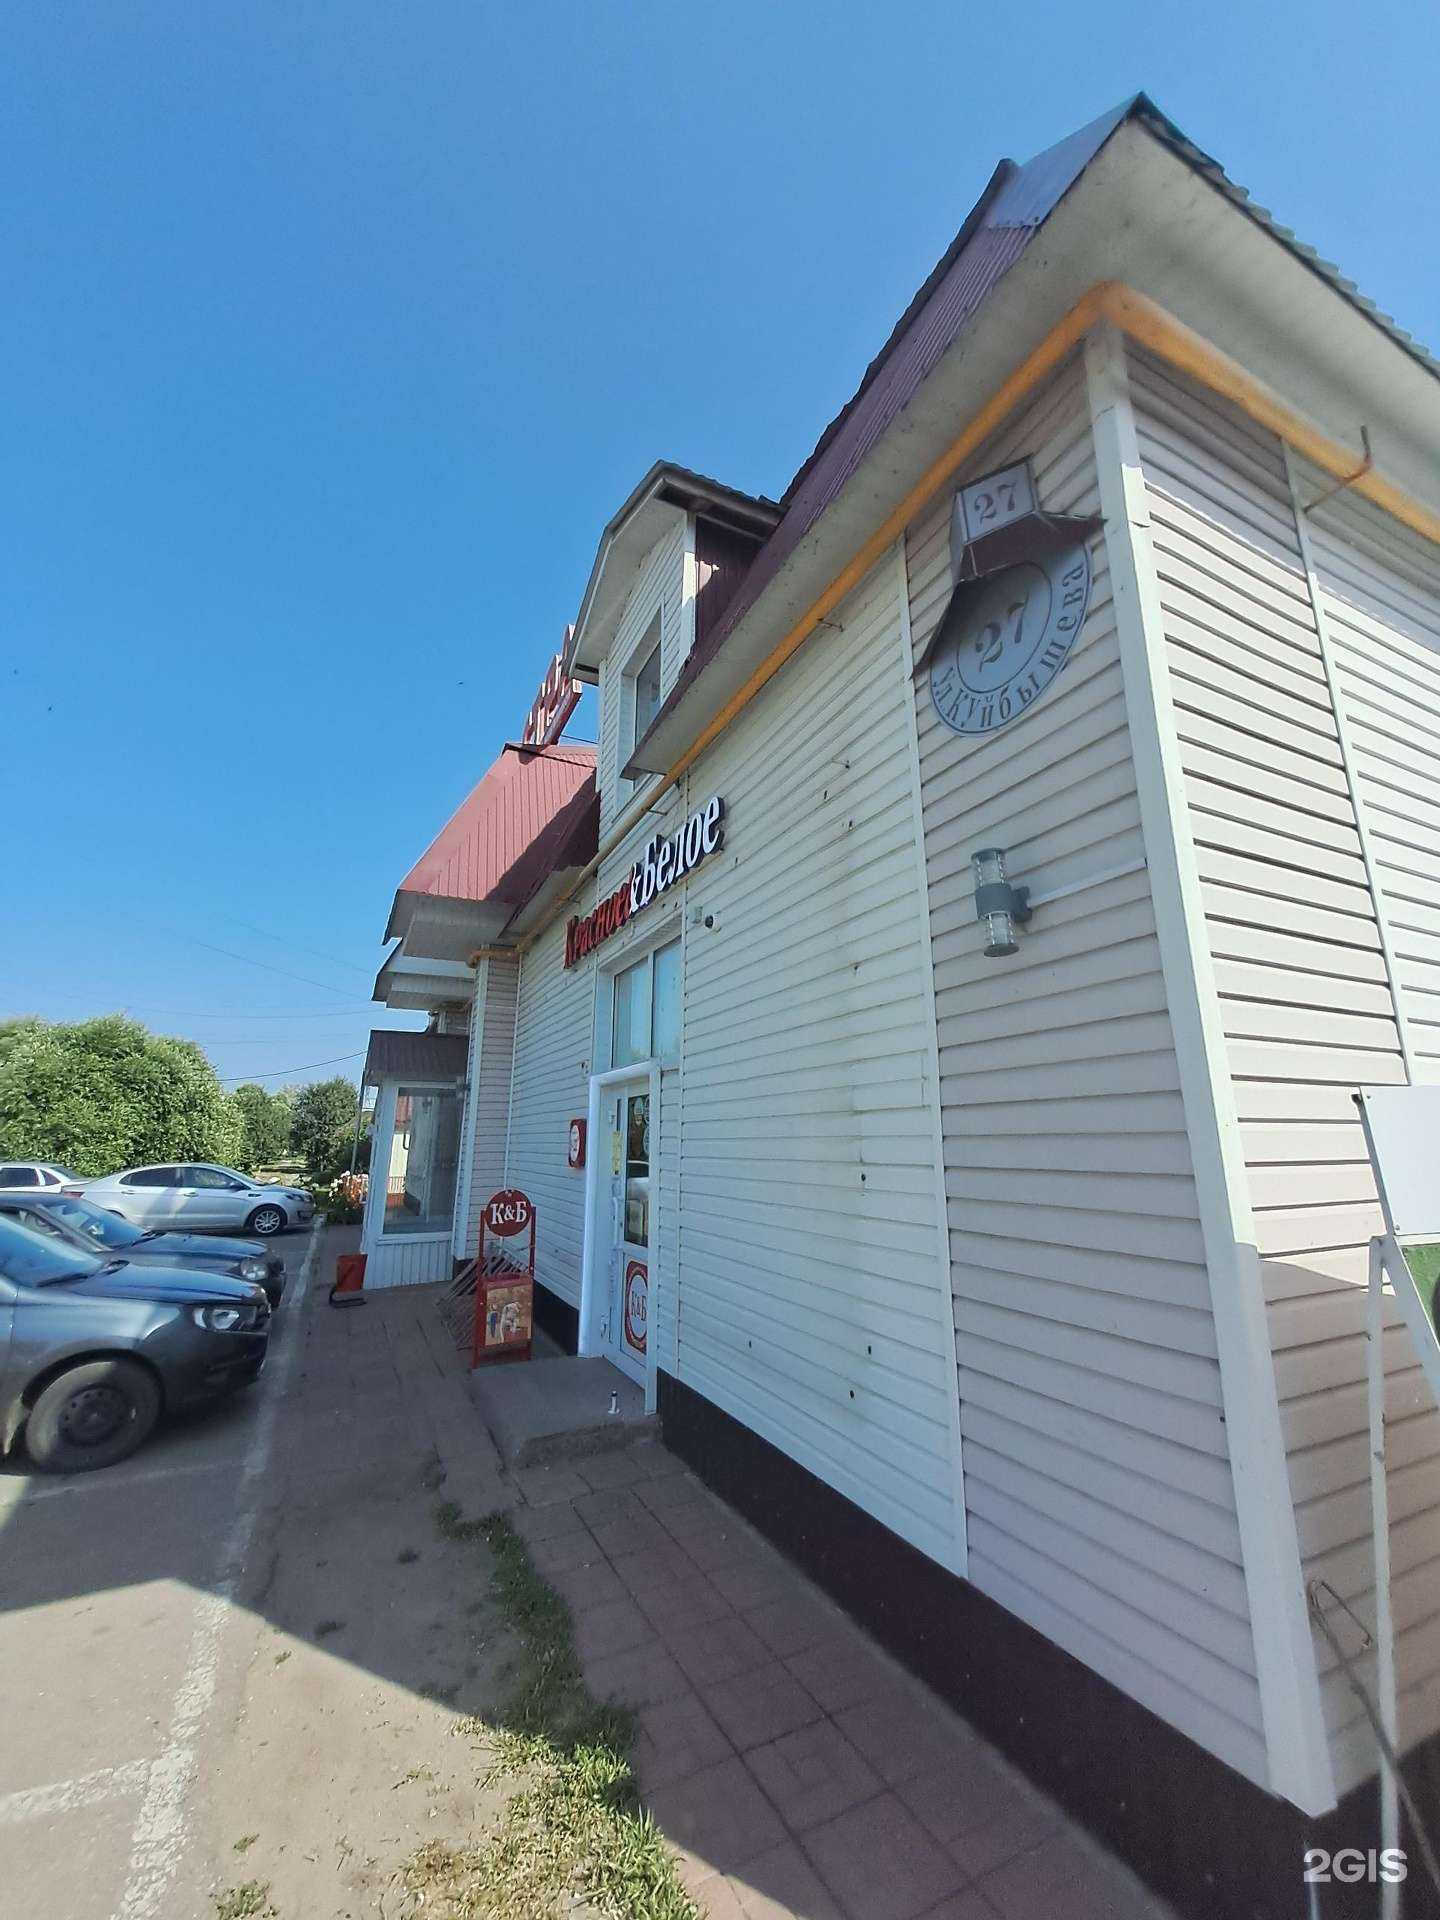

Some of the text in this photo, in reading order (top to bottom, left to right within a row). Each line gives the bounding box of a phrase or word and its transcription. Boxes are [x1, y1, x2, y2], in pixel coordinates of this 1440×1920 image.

[974, 480, 1018, 525] 27
[974, 595, 1029, 673] 27
[490, 1200, 527, 1225] К&Б
